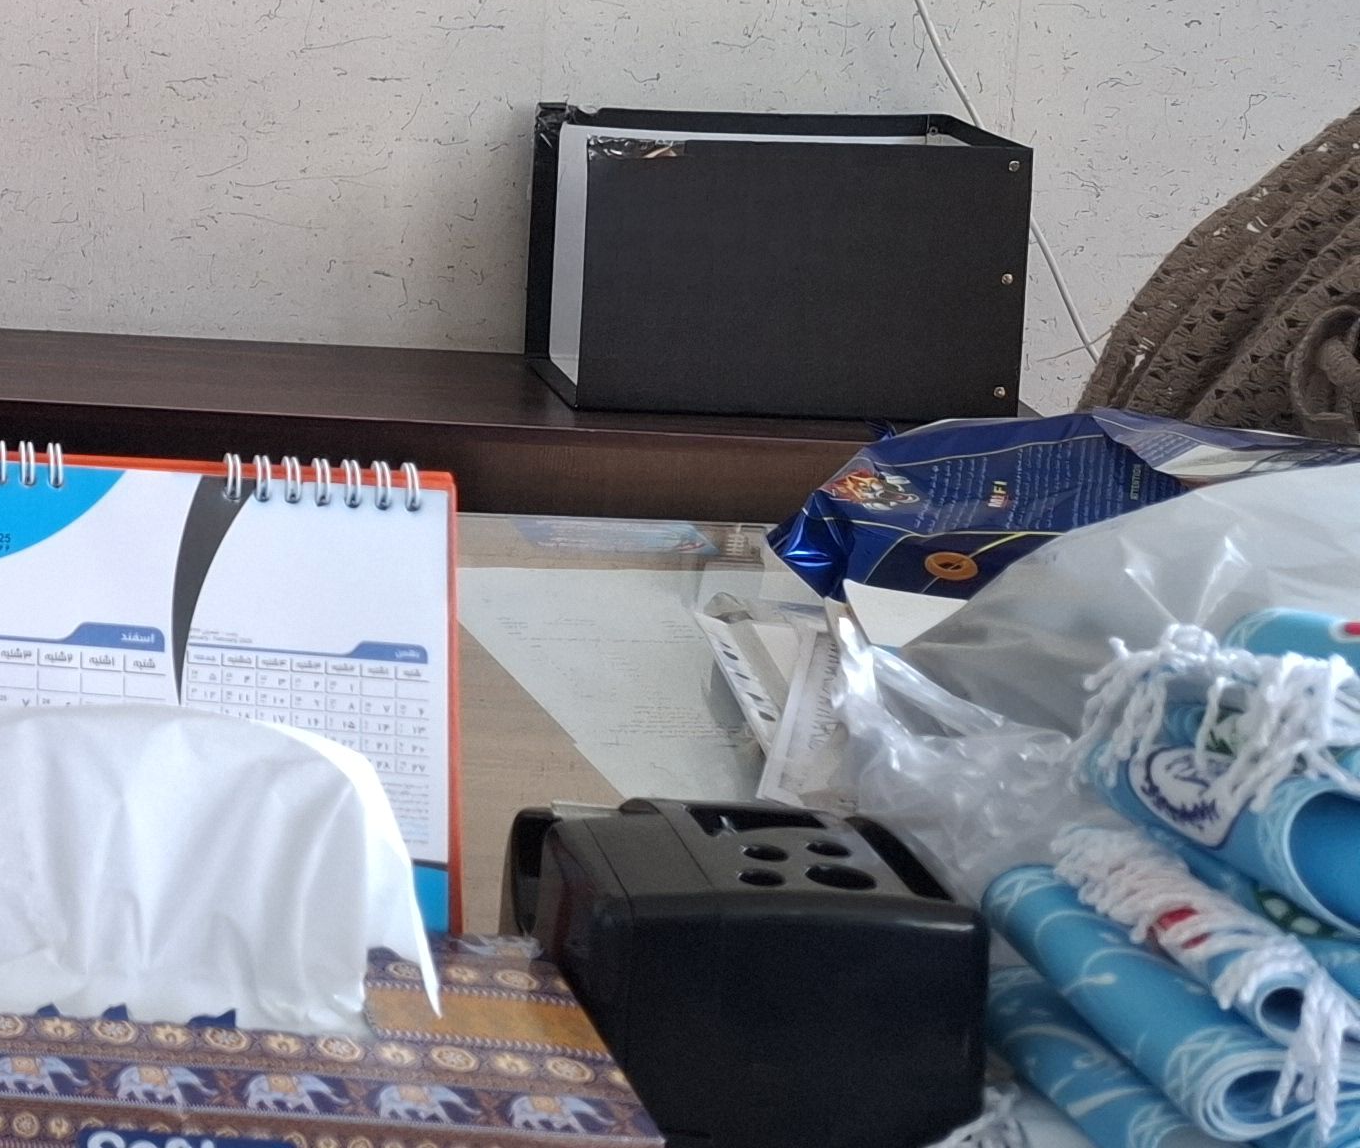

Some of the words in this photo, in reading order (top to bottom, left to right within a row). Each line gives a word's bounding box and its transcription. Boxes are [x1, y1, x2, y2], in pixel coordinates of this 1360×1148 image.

[120, 632, 156, 644] اسفند
[1, 647, 32, 660] ۳شنبه
[44, 650, 73, 664] ۲شنبه
[89, 654, 115, 667] ۱شنبه
[133, 658, 156, 671] شنبه
